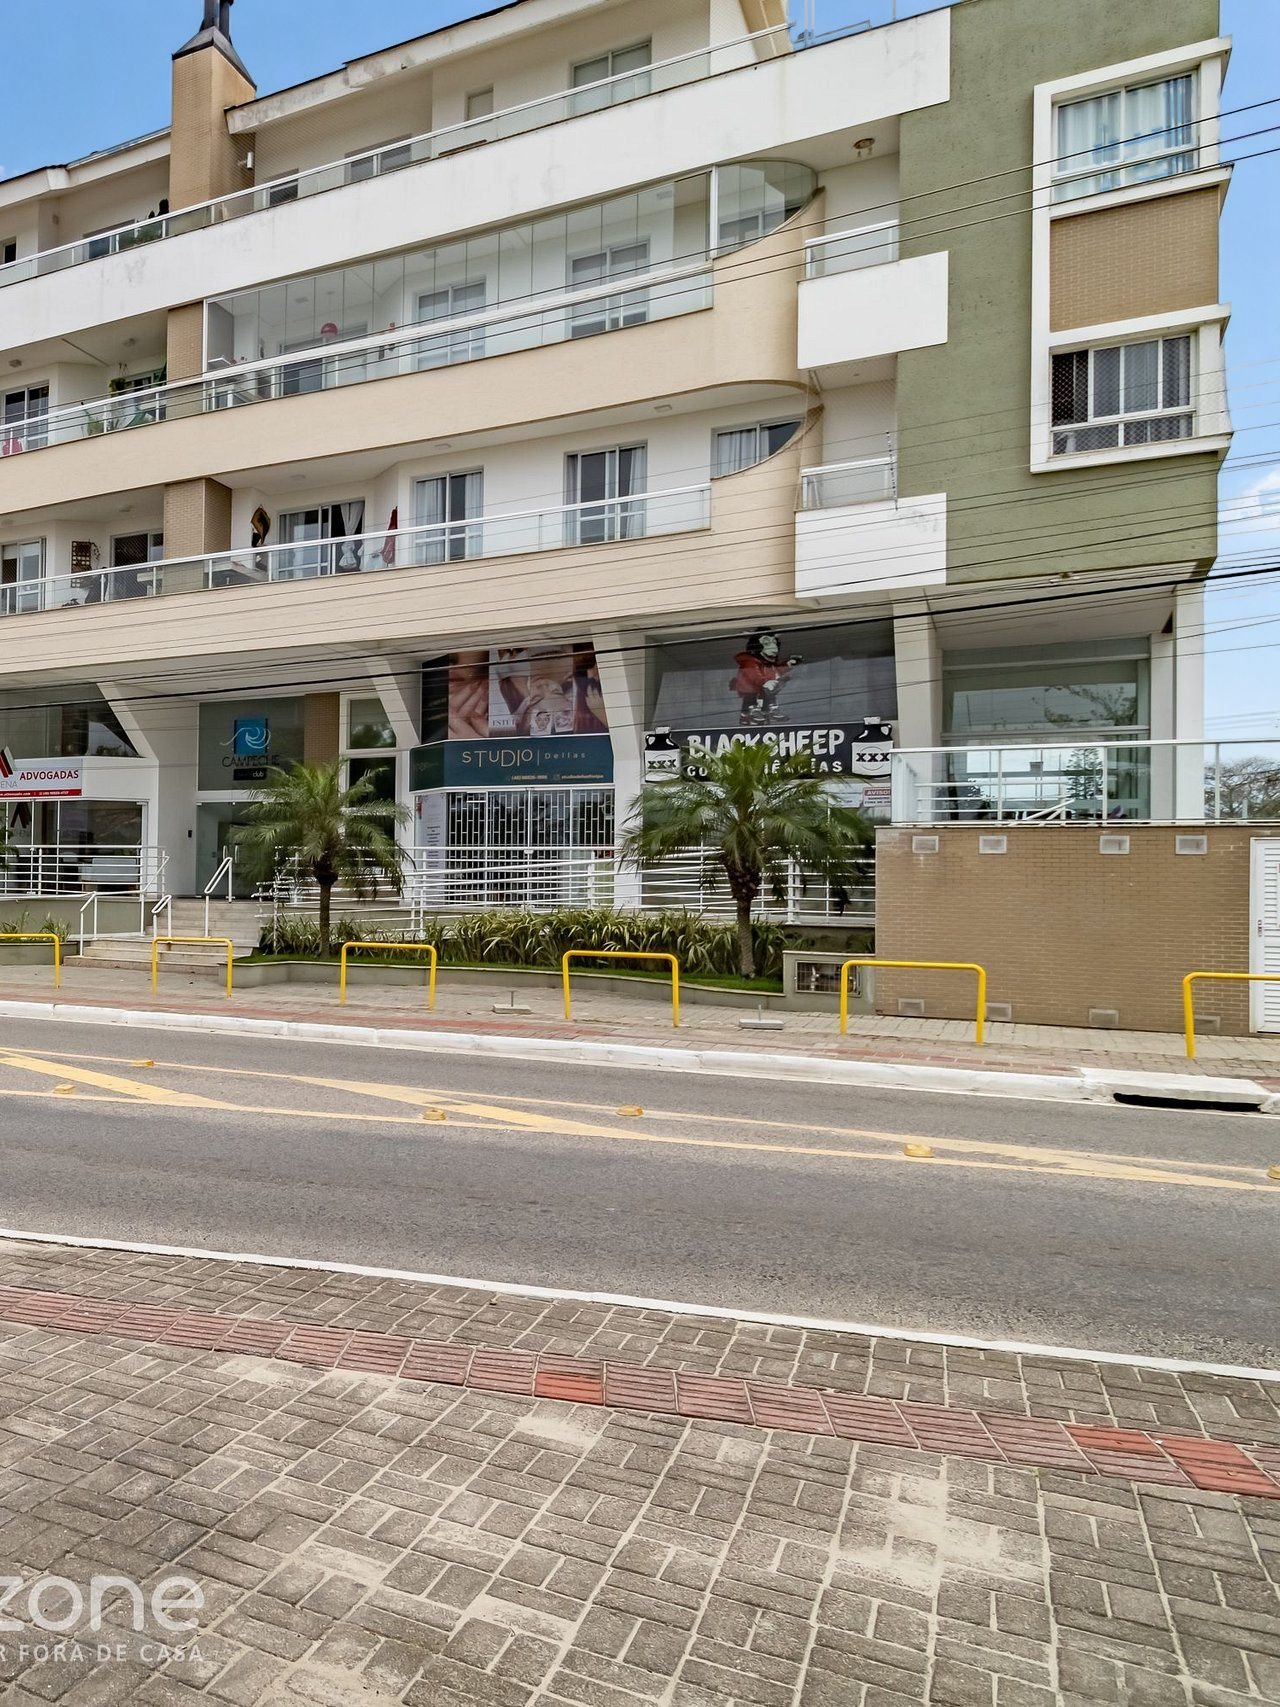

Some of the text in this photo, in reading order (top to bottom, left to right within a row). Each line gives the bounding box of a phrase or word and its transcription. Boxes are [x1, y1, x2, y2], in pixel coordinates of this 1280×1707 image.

[222, 755, 281, 768] CAMPECHE
[462, 749, 586, 768] STUDIO Dellas
[856, 753, 890, 762] XXX
[19, 769, 79, 780] ADVOGADAS
